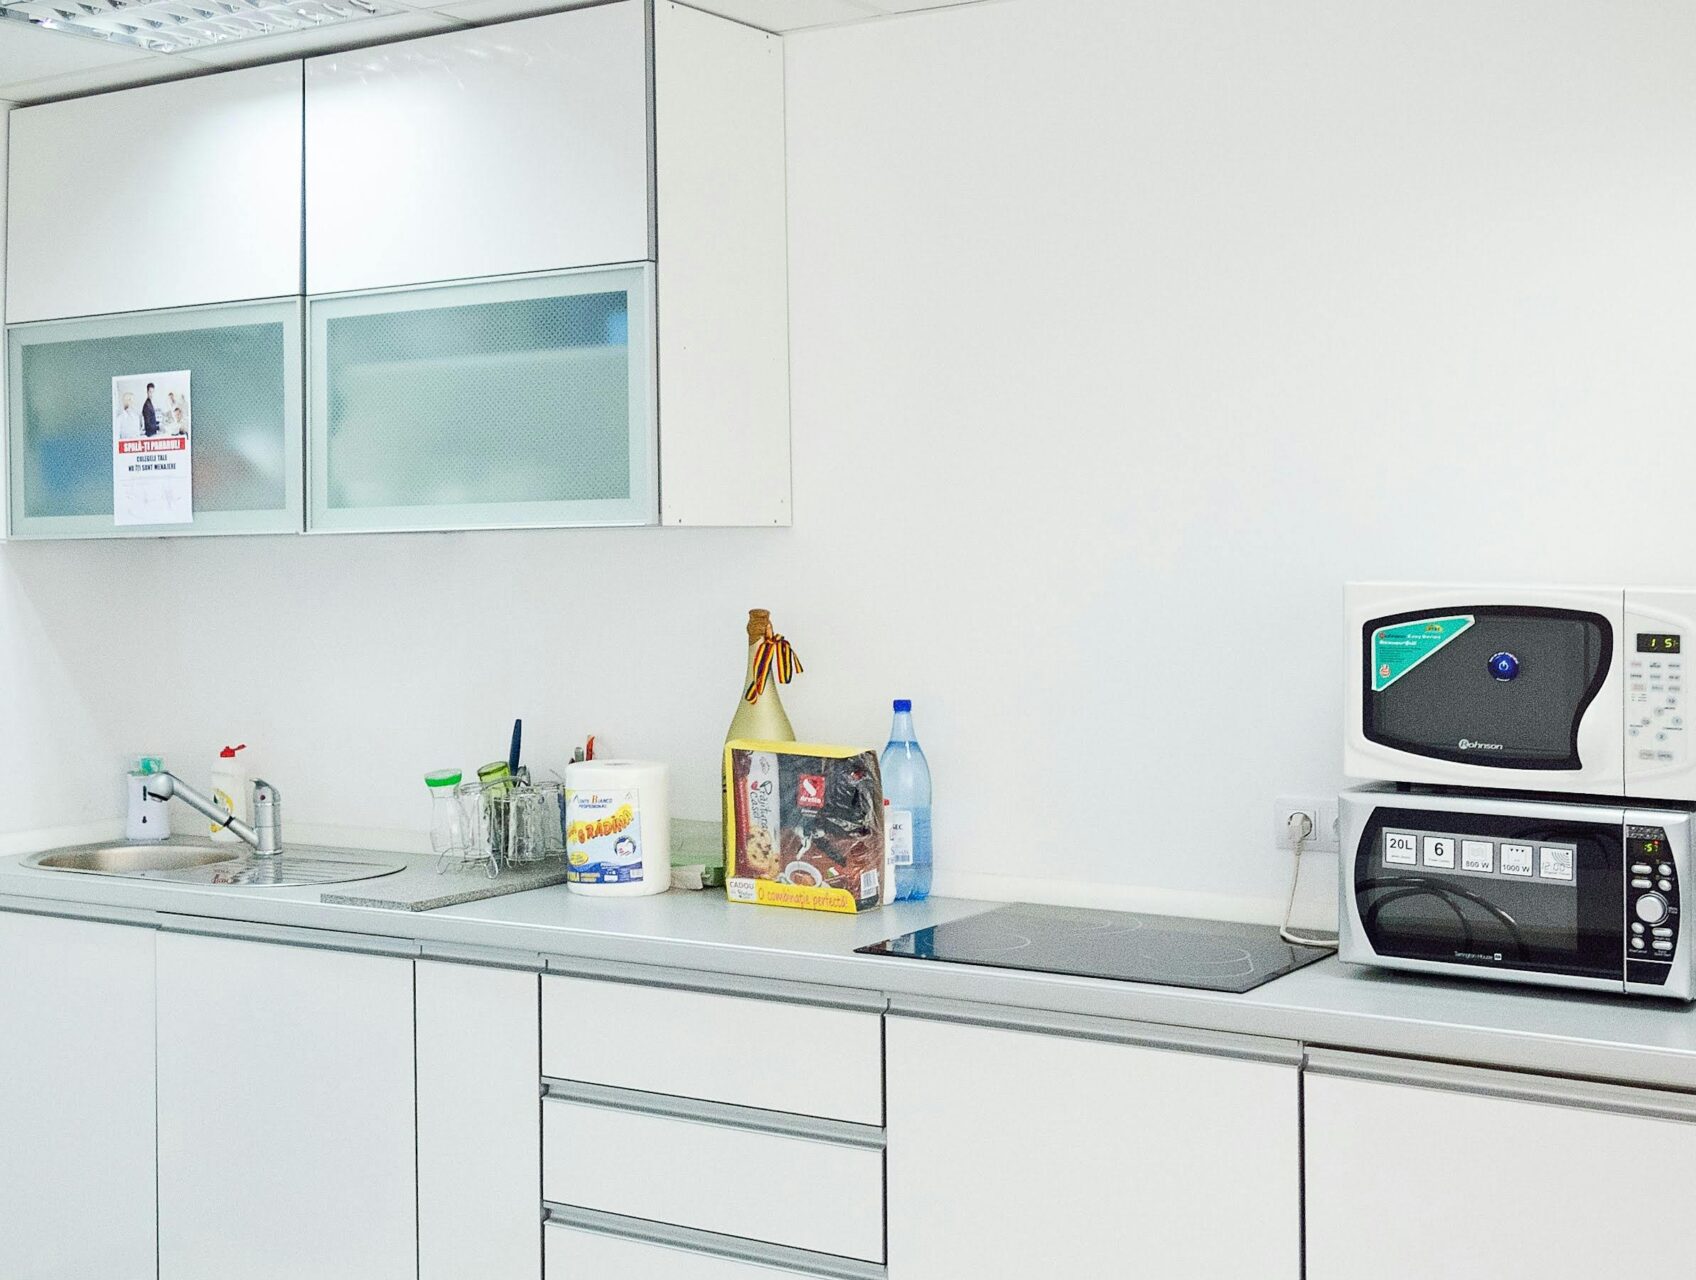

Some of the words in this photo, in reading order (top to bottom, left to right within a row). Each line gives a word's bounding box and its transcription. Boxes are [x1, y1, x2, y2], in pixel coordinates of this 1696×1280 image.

[1458, 738, 1503, 750] Rohnson
[1389, 838, 1413, 850] 20L
[1434, 842, 1444, 857] 6
[1465, 860, 1480, 868] 800
[1481, 861, 1490, 869] W
[1503, 863, 1520, 872] 1000
[1521, 865, 1531, 873] W
[729, 881, 755, 890] CADOU
